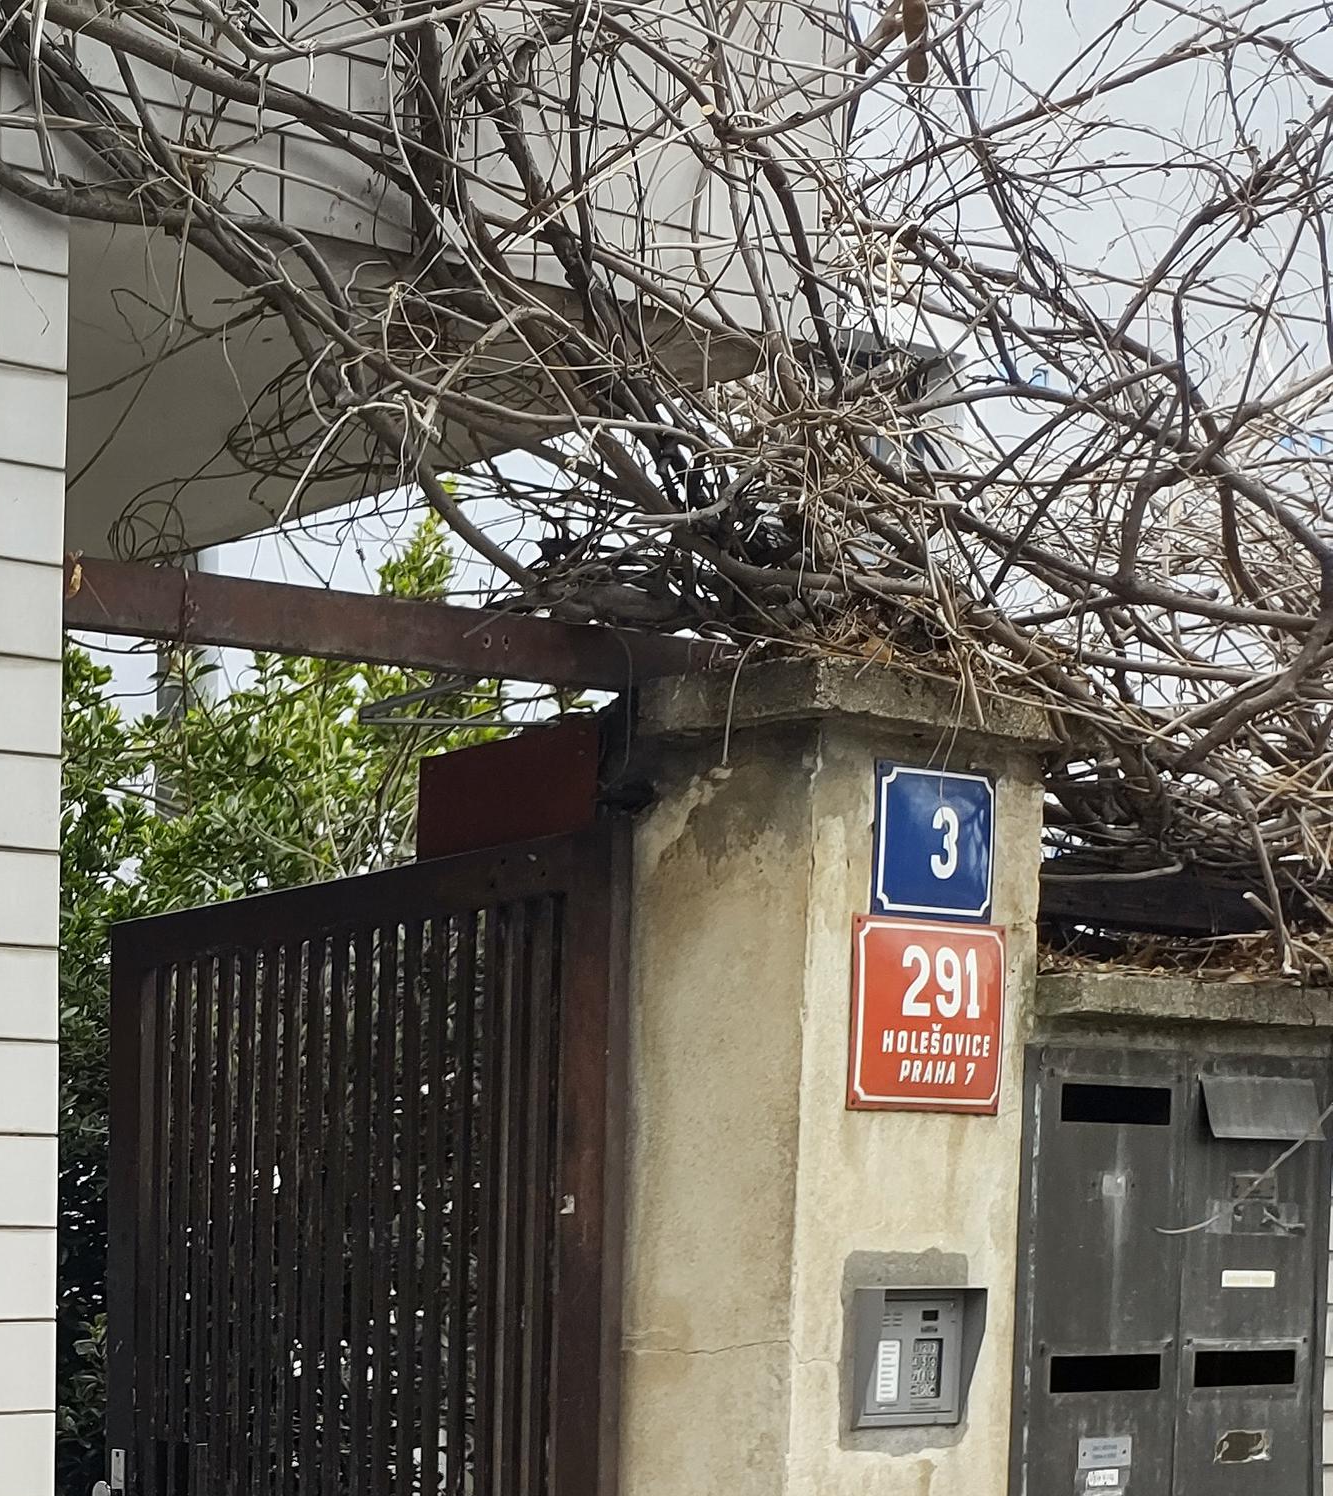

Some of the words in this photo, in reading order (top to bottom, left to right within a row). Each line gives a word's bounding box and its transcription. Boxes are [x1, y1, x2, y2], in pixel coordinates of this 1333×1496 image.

[930, 806, 959, 879] 3
[901, 944, 980, 1019] 291
[881, 1023, 991, 1058] HOLEŠOVICE
[898, 1059, 956, 1085] PRAHA
[964, 1062, 976, 1085] 7
